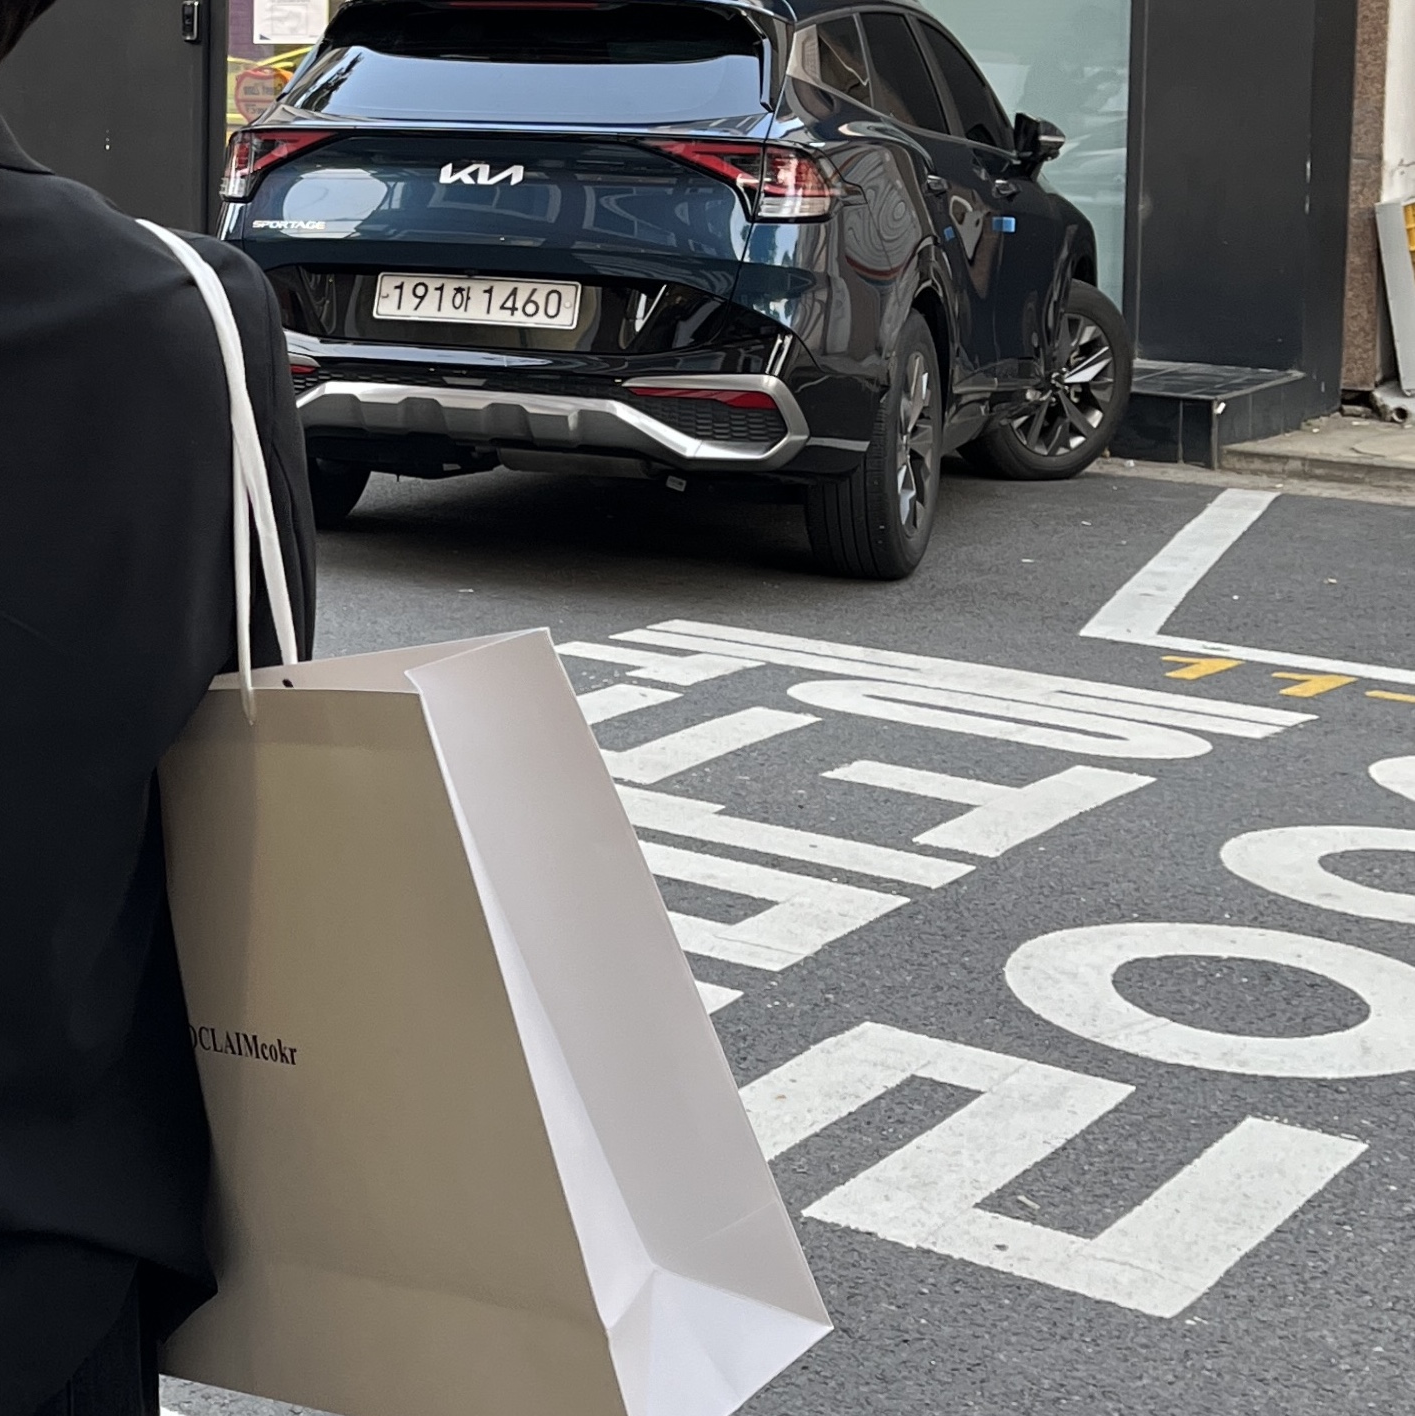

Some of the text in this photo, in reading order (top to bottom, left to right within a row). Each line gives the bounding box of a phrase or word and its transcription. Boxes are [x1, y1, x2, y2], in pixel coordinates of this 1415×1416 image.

[439, 162, 524, 186] KIA
[252, 219, 326, 231] SPORTAGE
[393, 281, 562, 319] 191하 1460
